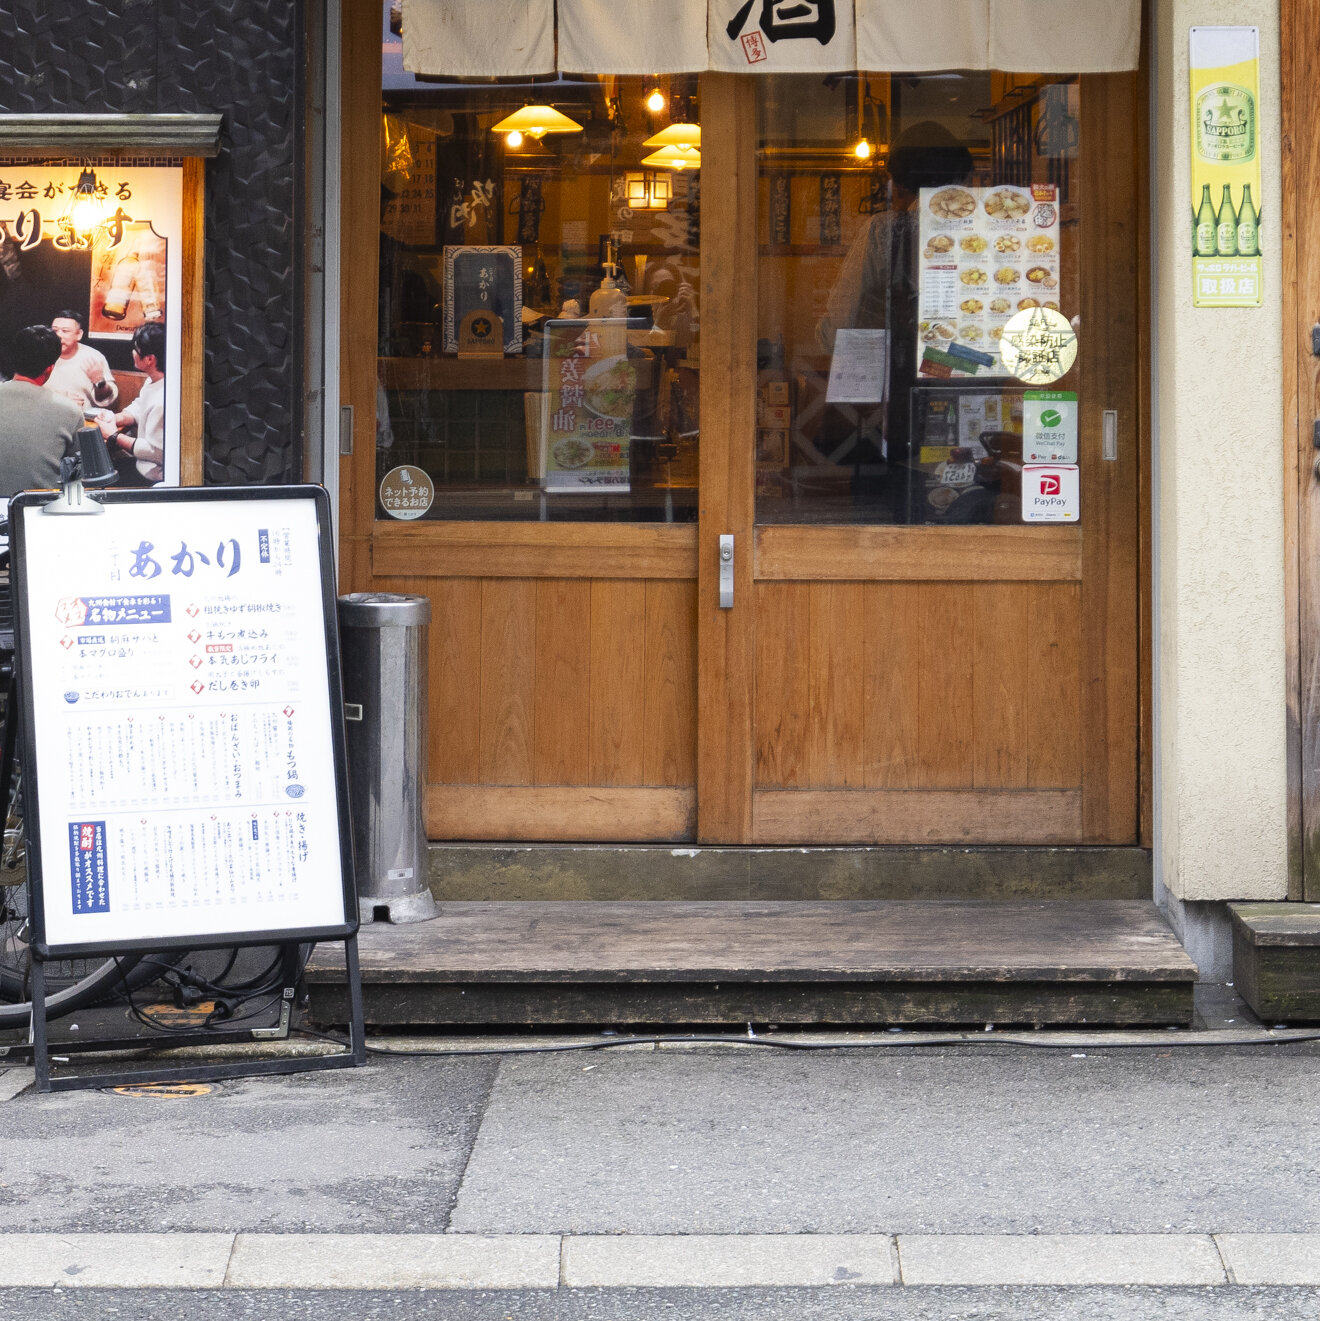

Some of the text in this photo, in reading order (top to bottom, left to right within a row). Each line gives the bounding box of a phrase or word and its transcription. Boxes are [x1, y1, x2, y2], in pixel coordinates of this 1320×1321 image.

[1206, 126, 1246, 136] SAPPORO
[1201, 278, 1256, 295] 取扱店
[384, 486, 430, 498] ネット予約
[384, 497, 430, 508] できるお店
[1034, 497, 1068, 507] PayPay
[128, 538, 242, 580] あかり
[89, 607, 164, 623] 名物メニュー
